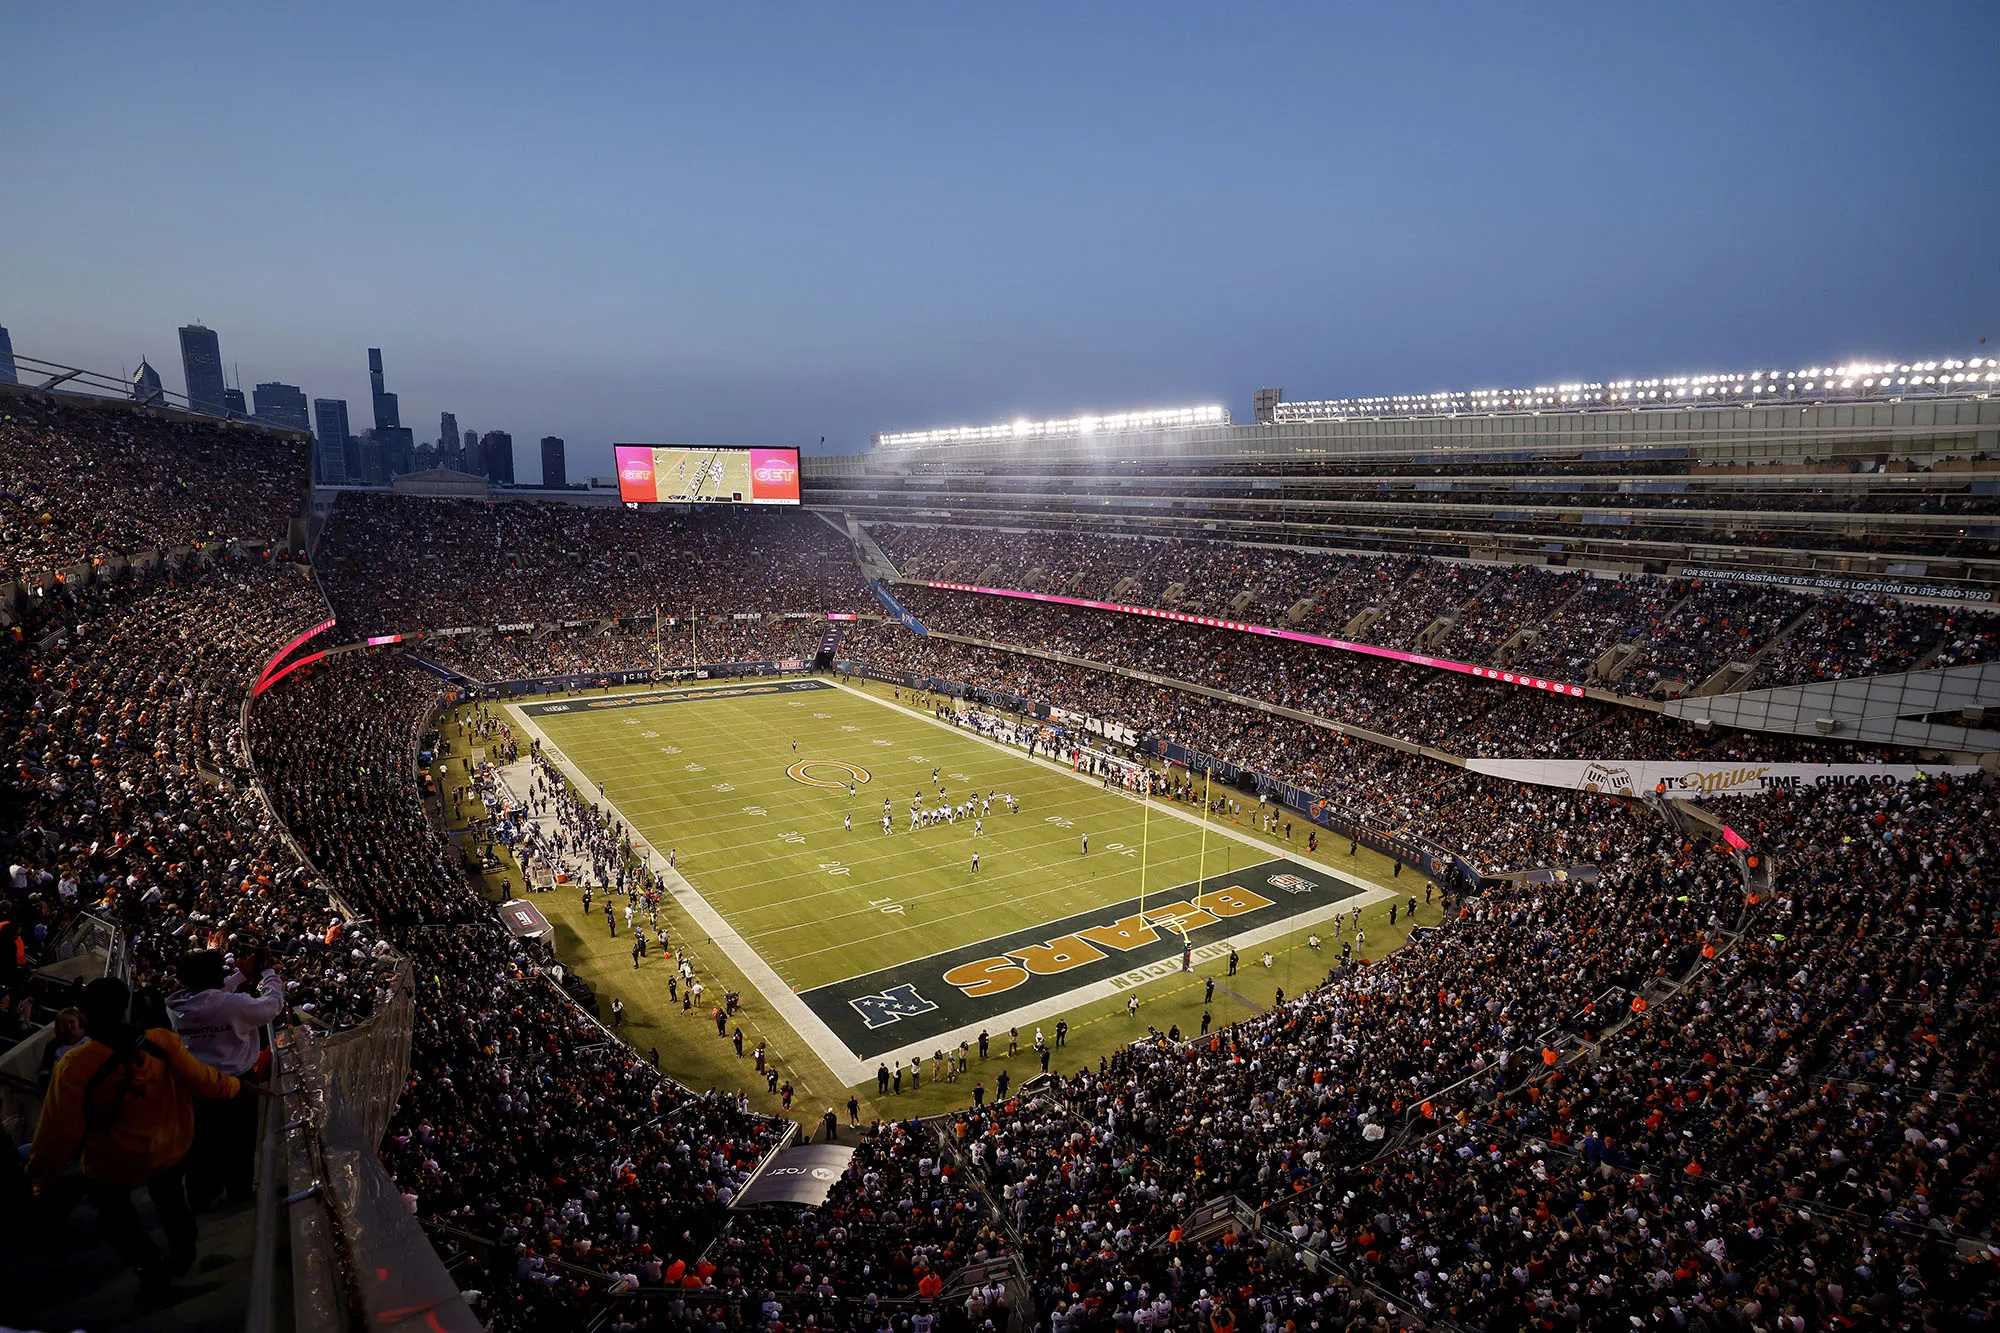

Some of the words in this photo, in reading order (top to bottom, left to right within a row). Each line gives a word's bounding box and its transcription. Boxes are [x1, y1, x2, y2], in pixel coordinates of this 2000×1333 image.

[622, 470, 651, 480] GET
[754, 468, 795, 482] GET
[1682, 568, 1698, 576] FOR
[1698, 570, 1790, 584] SECURITY/ASSISTANCE
[1792, 577, 1814, 586] TEXT
[1815, 579, 1842, 588] ISSUE
[1842, 581, 1850, 589] &
[1851, 582, 1901, 593] LOCATION
[1904, 586, 1917, 594] TO
[498, 623, 534, 632] DOWN
[588, 687, 778, 707] CHICAGO
[943, 680, 1003, 707] CHIAGO
[1184, 749, 1225, 775] BEAR
[1230, 767, 1301, 809] DWN
[1587, 770, 1606, 783] Lite
[1611, 775, 1630, 788] Lite
[1683, 767, 1769, 794] Miller
[1758, 776, 1800, 789] TIME
[1815, 775, 1896, 788] CHICAGO
[777, 831, 805, 843] 30
[1106, 843, 1138, 857] 10
[818, 861, 850, 876] 20
[868, 897, 904, 914] 10
[942, 885, 1276, 998] BEARS
[1195, 941, 1237, 959] END
